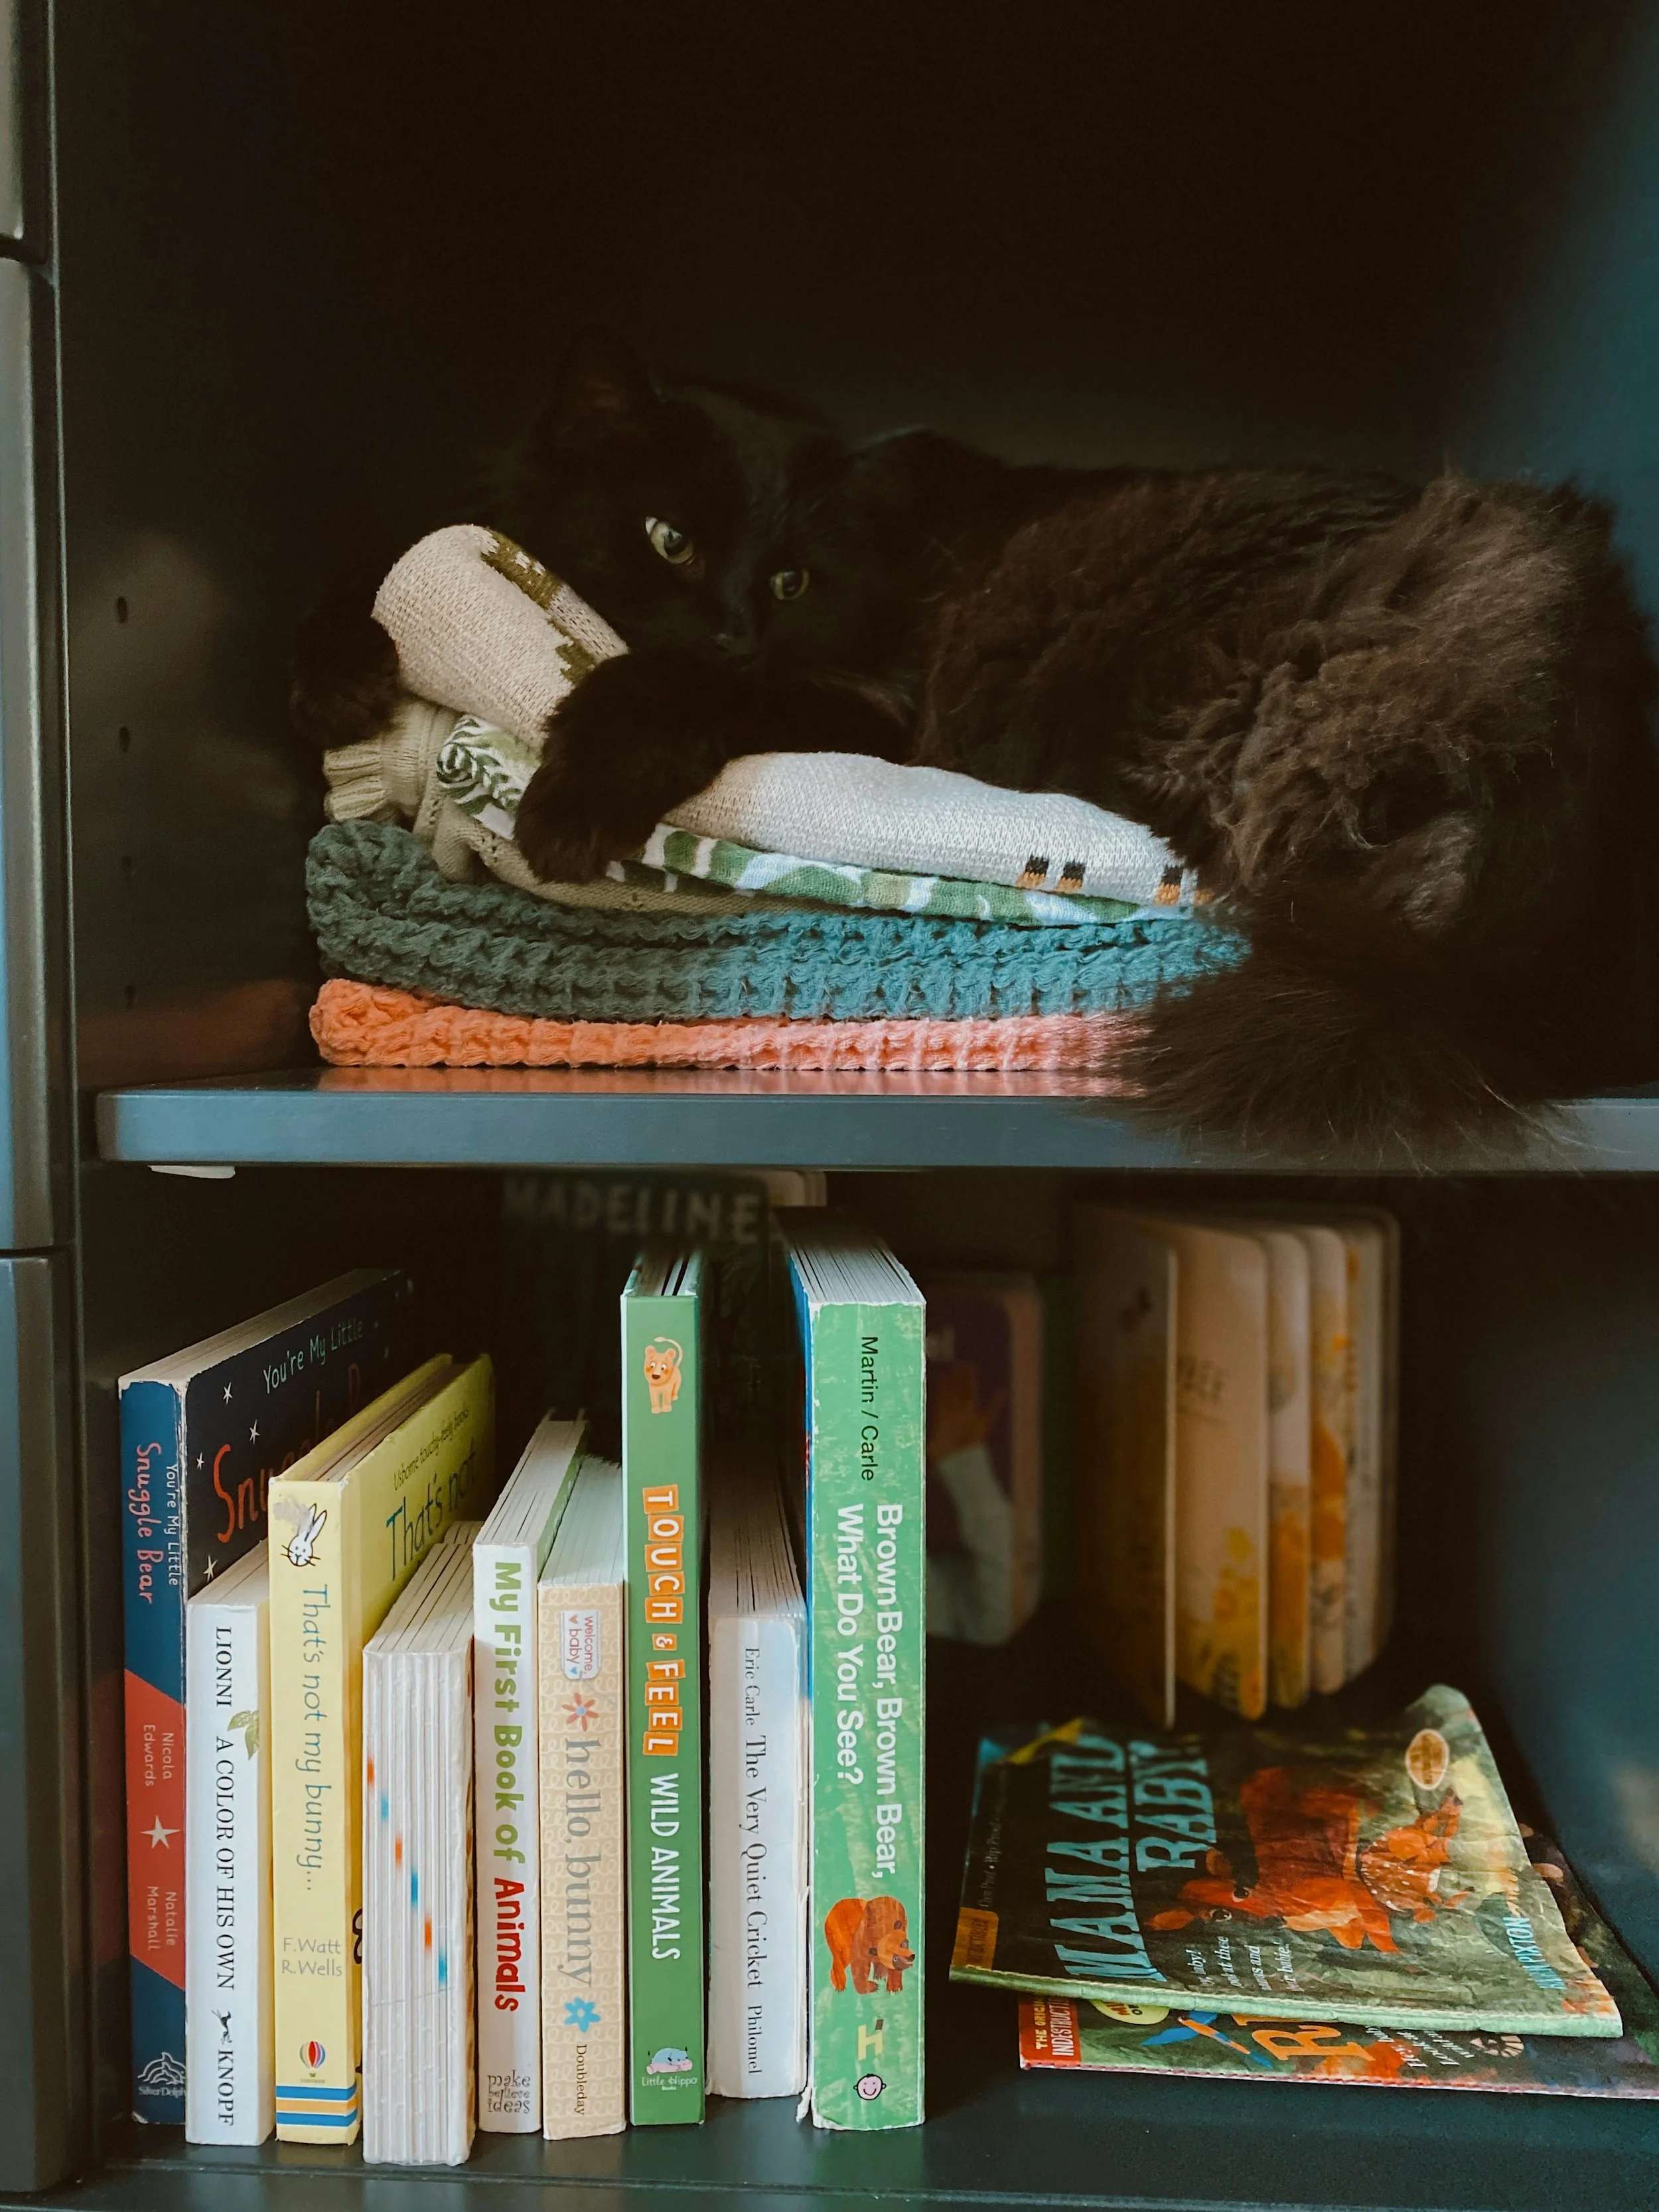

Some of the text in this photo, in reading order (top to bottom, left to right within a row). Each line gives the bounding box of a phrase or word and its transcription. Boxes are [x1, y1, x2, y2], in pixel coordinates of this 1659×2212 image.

[263, 1319, 364, 1394] You're My Little
[861, 1337, 879, 1481] Martin / Carle
[128, 1442, 164, 1604] Snuggle Bear
[163, 1463, 182, 1586] You're My Little
[386, 1436, 475, 1581] That's not
[303, 1584, 331, 1663] That's
[567, 1628, 581, 1664] baby
[837, 1503, 863, 1785] What Do You See?
[304, 1674, 327, 1722] not
[872, 1504, 903, 1879] Brown Bear, Brown Bear,
[143, 1724, 157, 1787] Edwards
[162, 1732, 175, 1779] Nicola
[295, 1733, 321, 1773] my
[646, 1491, 681, 1960] TOUCH & FEEL WILD ANIMALS
[489, 1562, 526, 2012] My First Book of Animals
[216, 1626, 234, 2126] LIONNI A COLOR OF HIS OWN KNOPF
[557, 1737, 602, 1988] hello, bunny
[739, 1647, 768, 2075] Eric Carle The Very Quiet Cricket Philomel
[1045, 1734, 1167, 1982] MAMA AND
[147, 1886, 161, 1951] Marshall
[165, 1891, 178, 1946] Natalie
[1503, 1917, 1546, 1963] PIXTON
[1244, 1945, 1262, 1966] and
[1035, 2029, 1048, 2049] THE
[1391, 2045, 1429, 2067] Hey,
[1396, 2031, 1461, 2066] Look at
[1433, 2039, 1475, 2058] wild
[487, 2069, 531, 2088] make
[488, 2090, 530, 2114] ideas
[573, 2044, 587, 2116] Doubleday
[642, 2075, 698, 2088] Little Hippo
